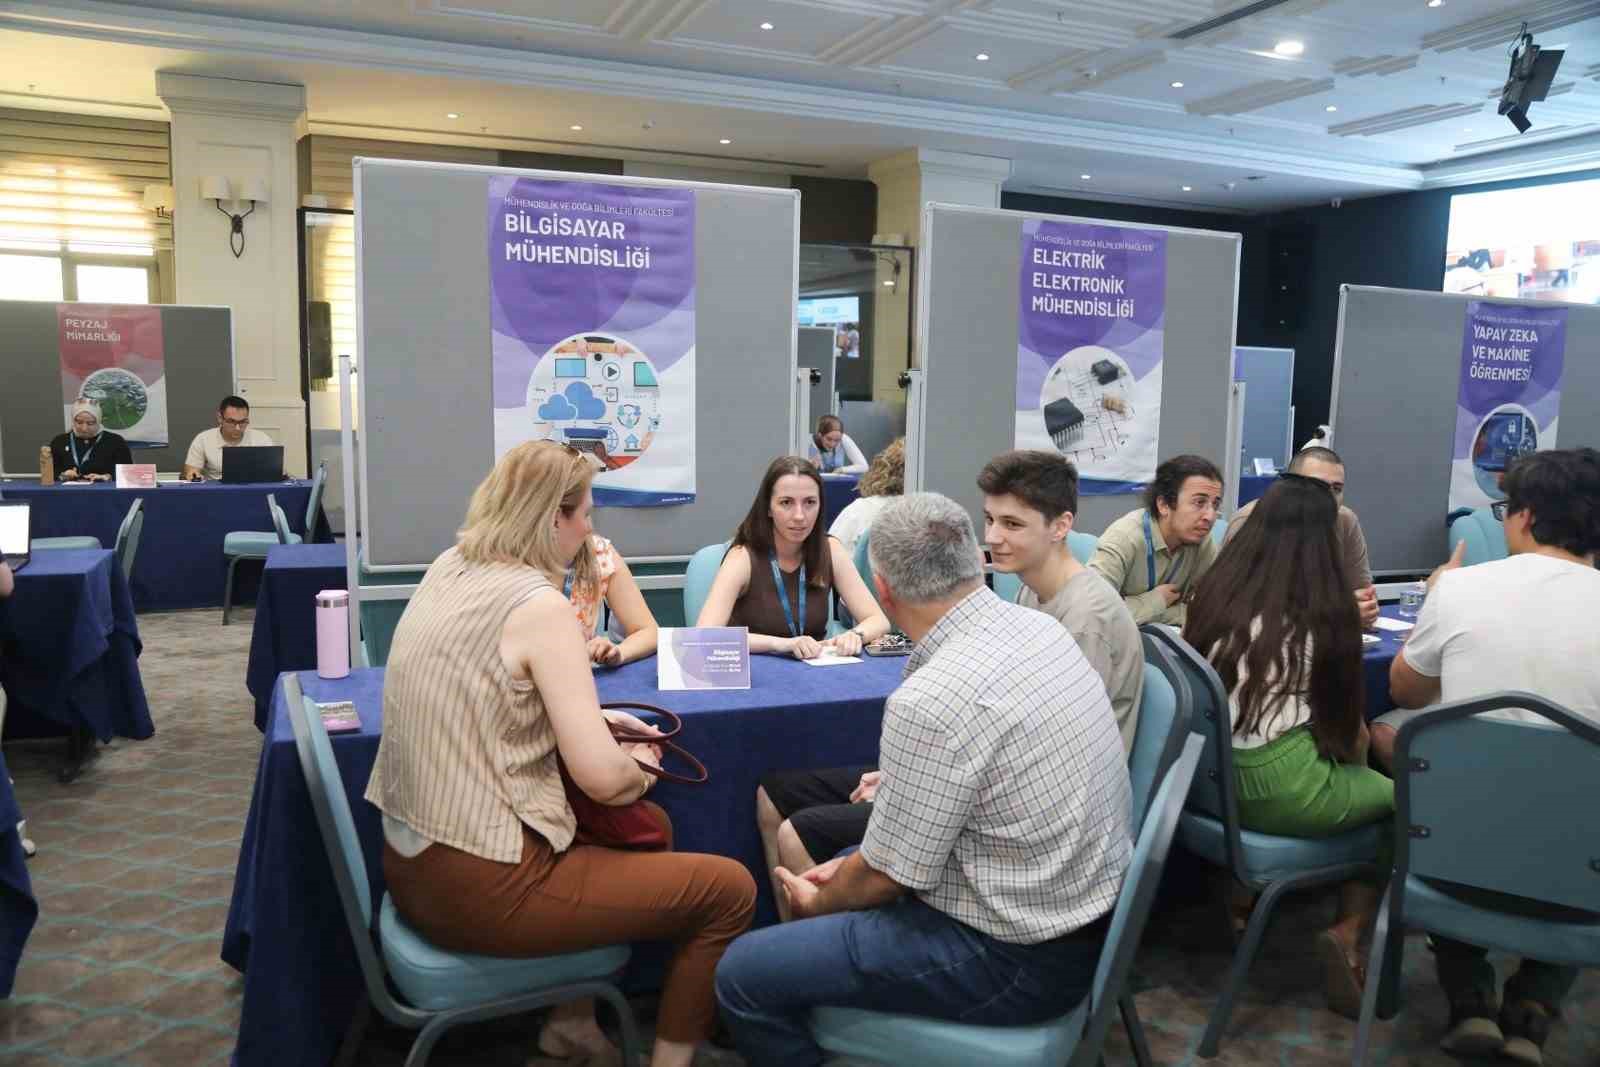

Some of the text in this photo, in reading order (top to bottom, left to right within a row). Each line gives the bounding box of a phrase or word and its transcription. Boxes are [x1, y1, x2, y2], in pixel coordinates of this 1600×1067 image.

[505, 210, 625, 240] BİLGİSAYAR
[506, 239, 650, 269] MÜHENDİSLİĞİ
[1034, 248, 1105, 270] ELEKTRİK
[1033, 272, 1125, 294] ELEKTRONİK
[1032, 294, 1135, 318] MÜHENDİSLİĞİ
[65, 318, 109, 329] PEYZAJ
[1473, 325, 1538, 342] YAPAY ZEKA
[1472, 345, 1531, 362] VE MAKİNE
[1471, 362, 1532, 381] ÖĞRENMESİ
